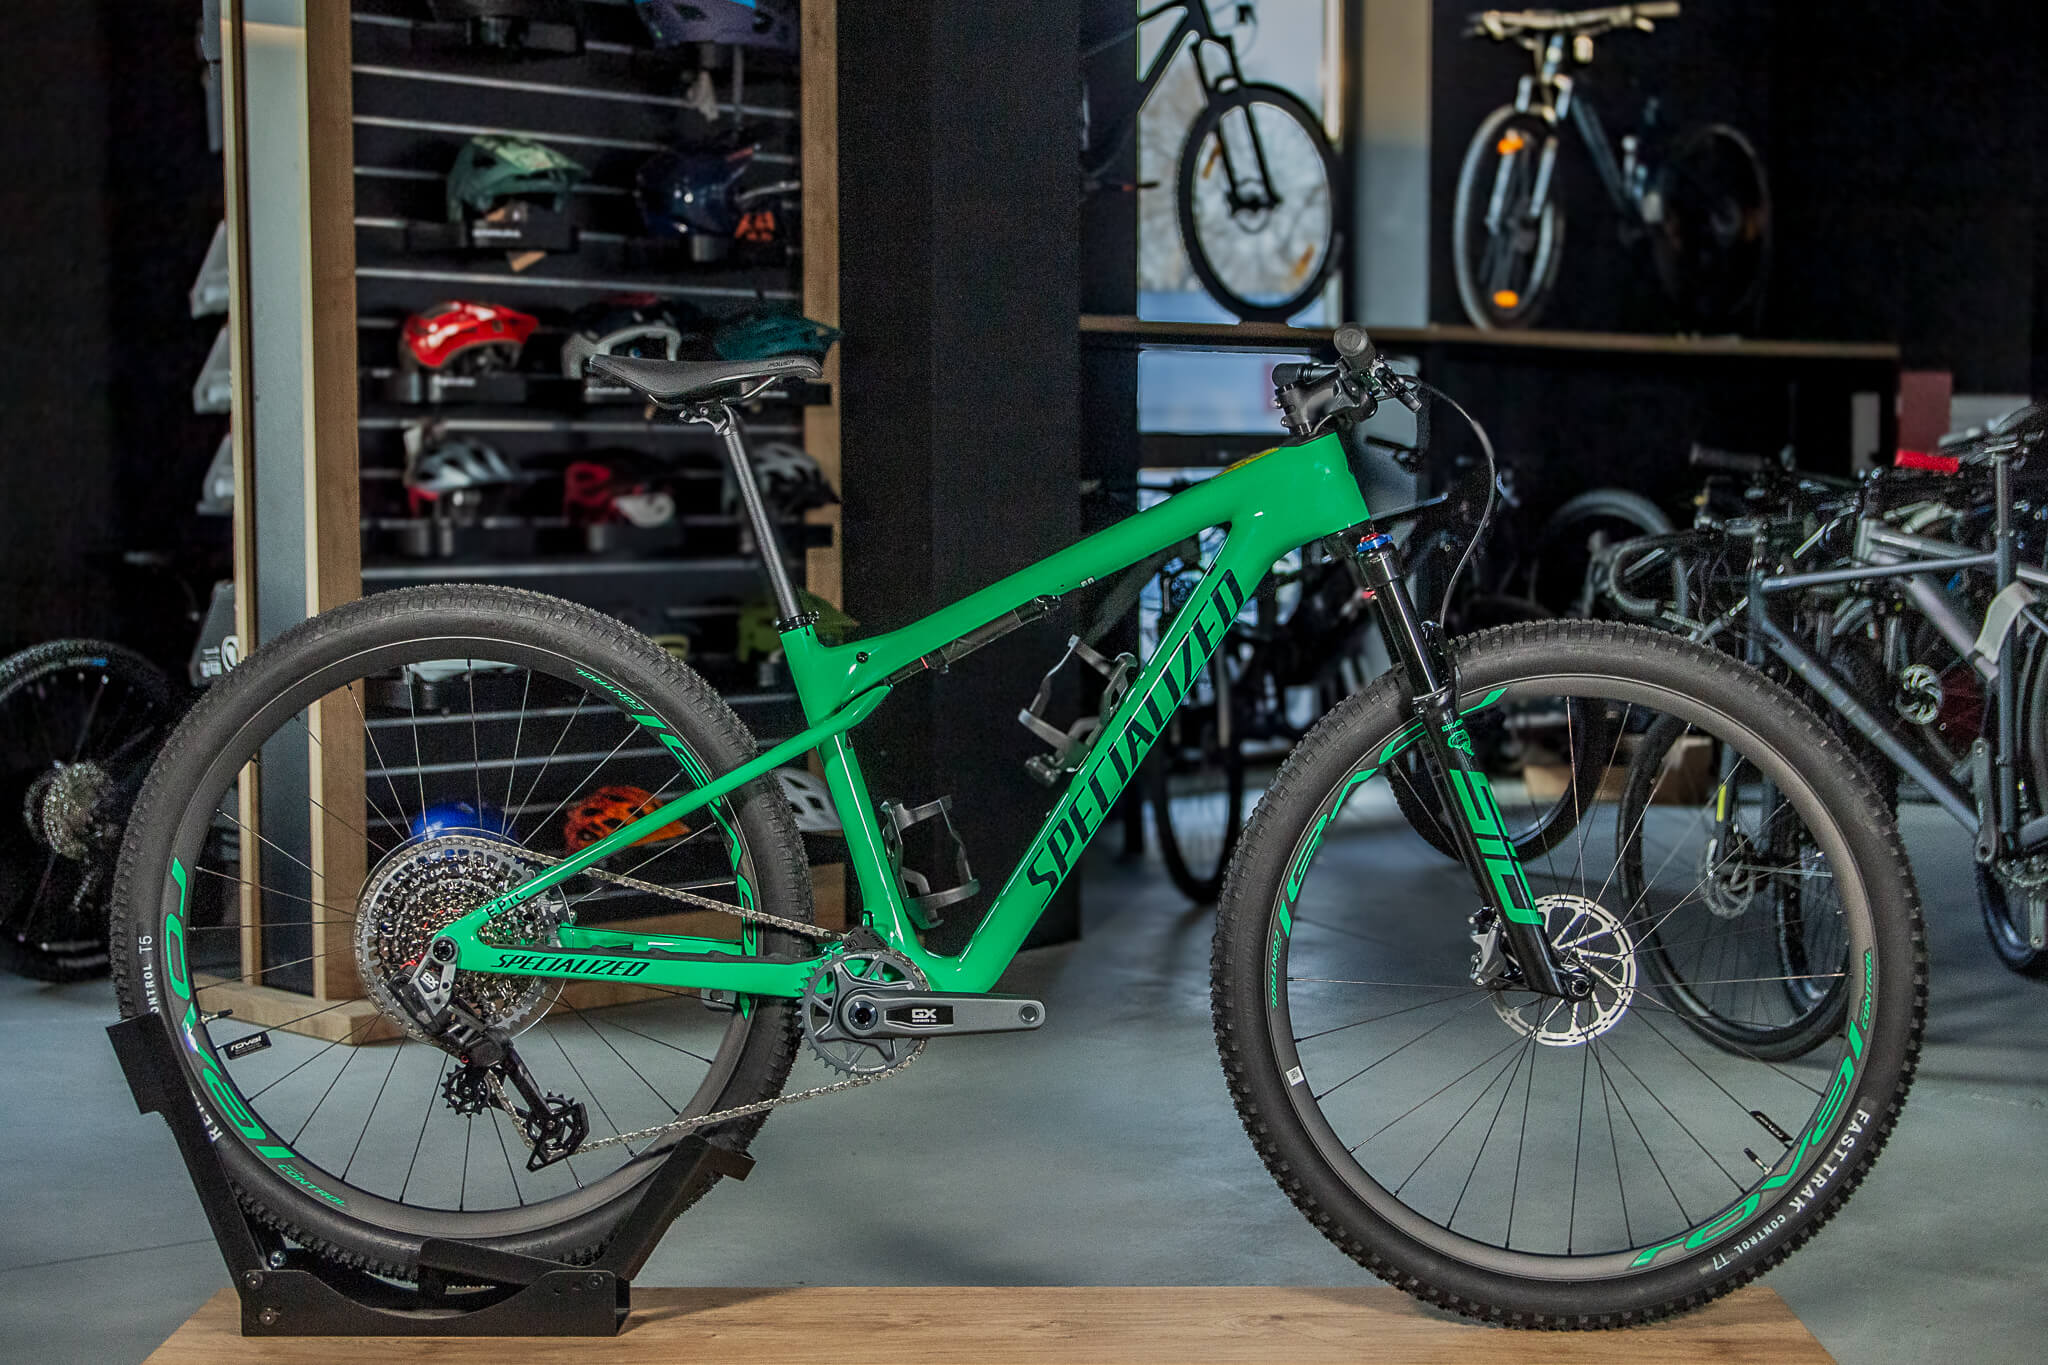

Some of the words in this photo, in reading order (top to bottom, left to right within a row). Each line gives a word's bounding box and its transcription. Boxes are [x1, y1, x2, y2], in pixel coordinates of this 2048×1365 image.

[575, 667, 645, 710] CONTROL
[1026, 568, 1244, 909] SPECIALIZED
[1449, 768, 1545, 926] SID
[485, 894, 527, 918] EPIC
[138, 935, 153, 954] T5
[490, 954, 650, 977] SPECIALIZED
[142, 963, 160, 1014] ONTROL
[1270, 929, 1280, 1009] CONTROL
[1861, 951, 1872, 1031] CONTROL
[911, 1008, 937, 1019] GX
[230, 1035, 263, 1052] roval
[1833, 1108, 1871, 1162] FAST
[277, 1164, 345, 1207] CONTROL
[1789, 1163, 1838, 1213] TRAK
[1734, 1214, 1787, 1256] CONTROL
[1712, 1253, 1731, 1271] T7
